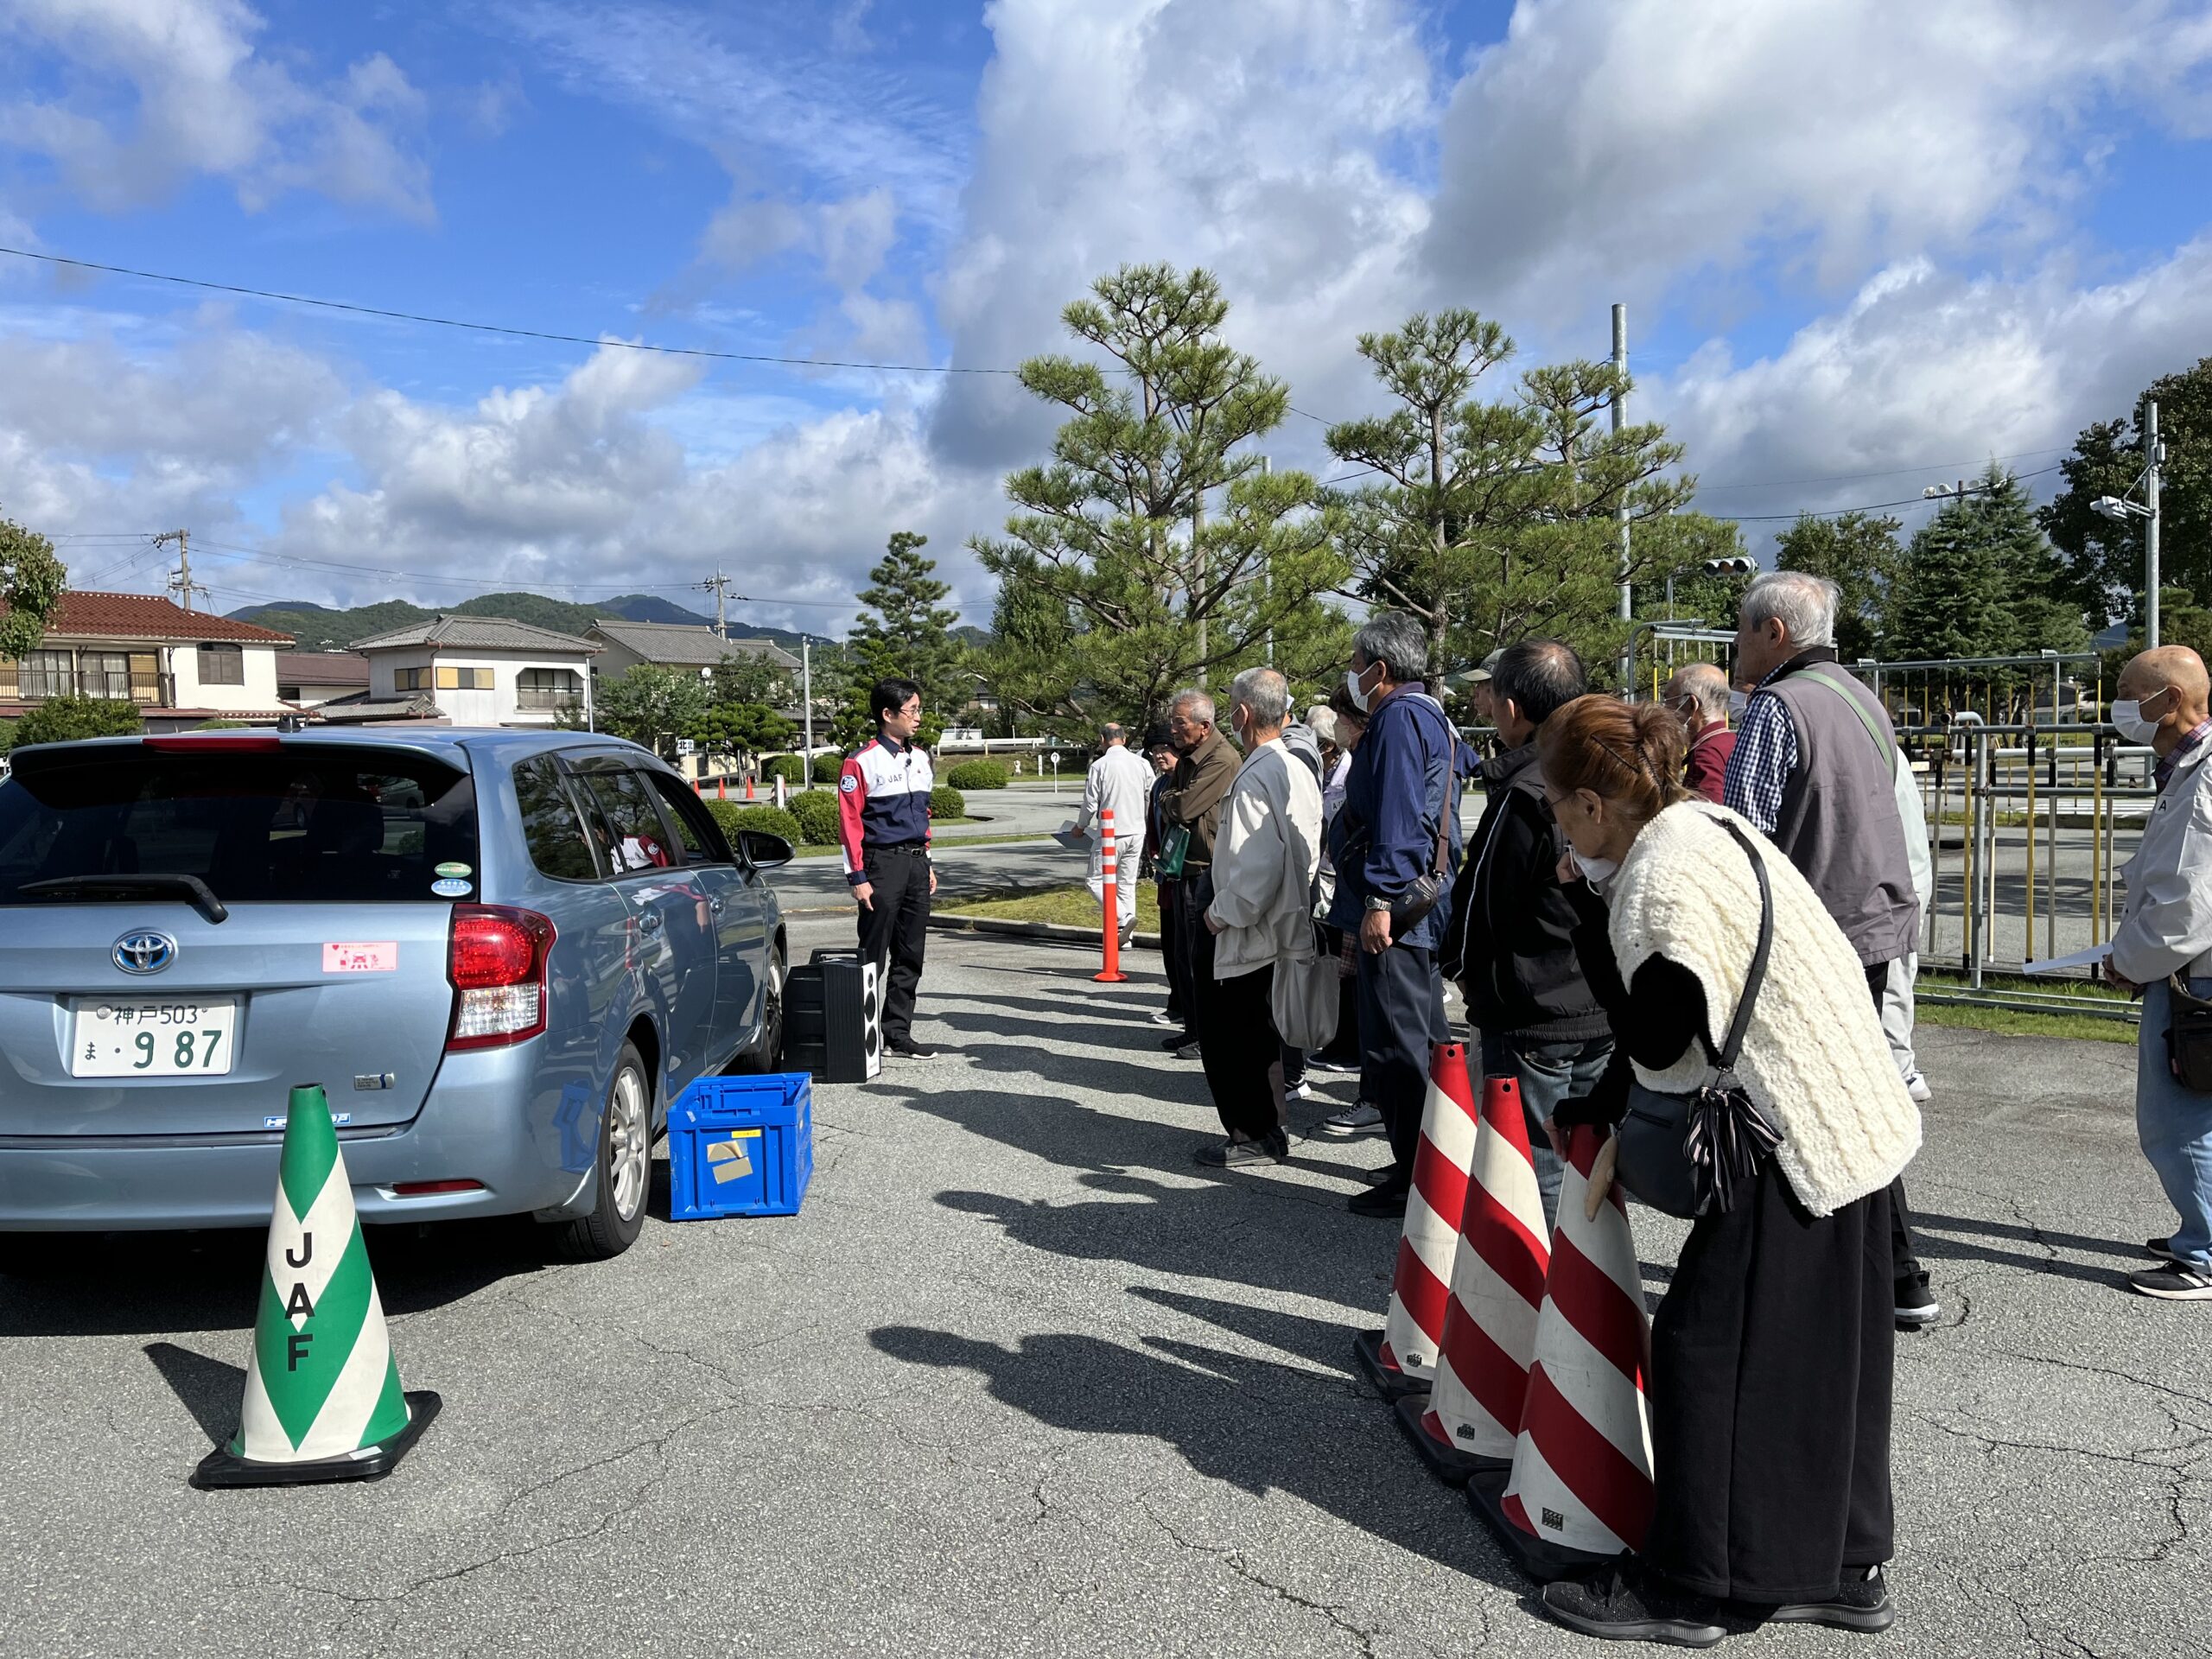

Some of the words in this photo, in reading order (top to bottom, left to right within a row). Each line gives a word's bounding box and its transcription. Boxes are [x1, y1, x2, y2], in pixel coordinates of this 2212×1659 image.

[888, 773, 903, 783] JAF
[85, 1041, 96, 1060] ま
[285, 1231, 316, 1372] JAF
